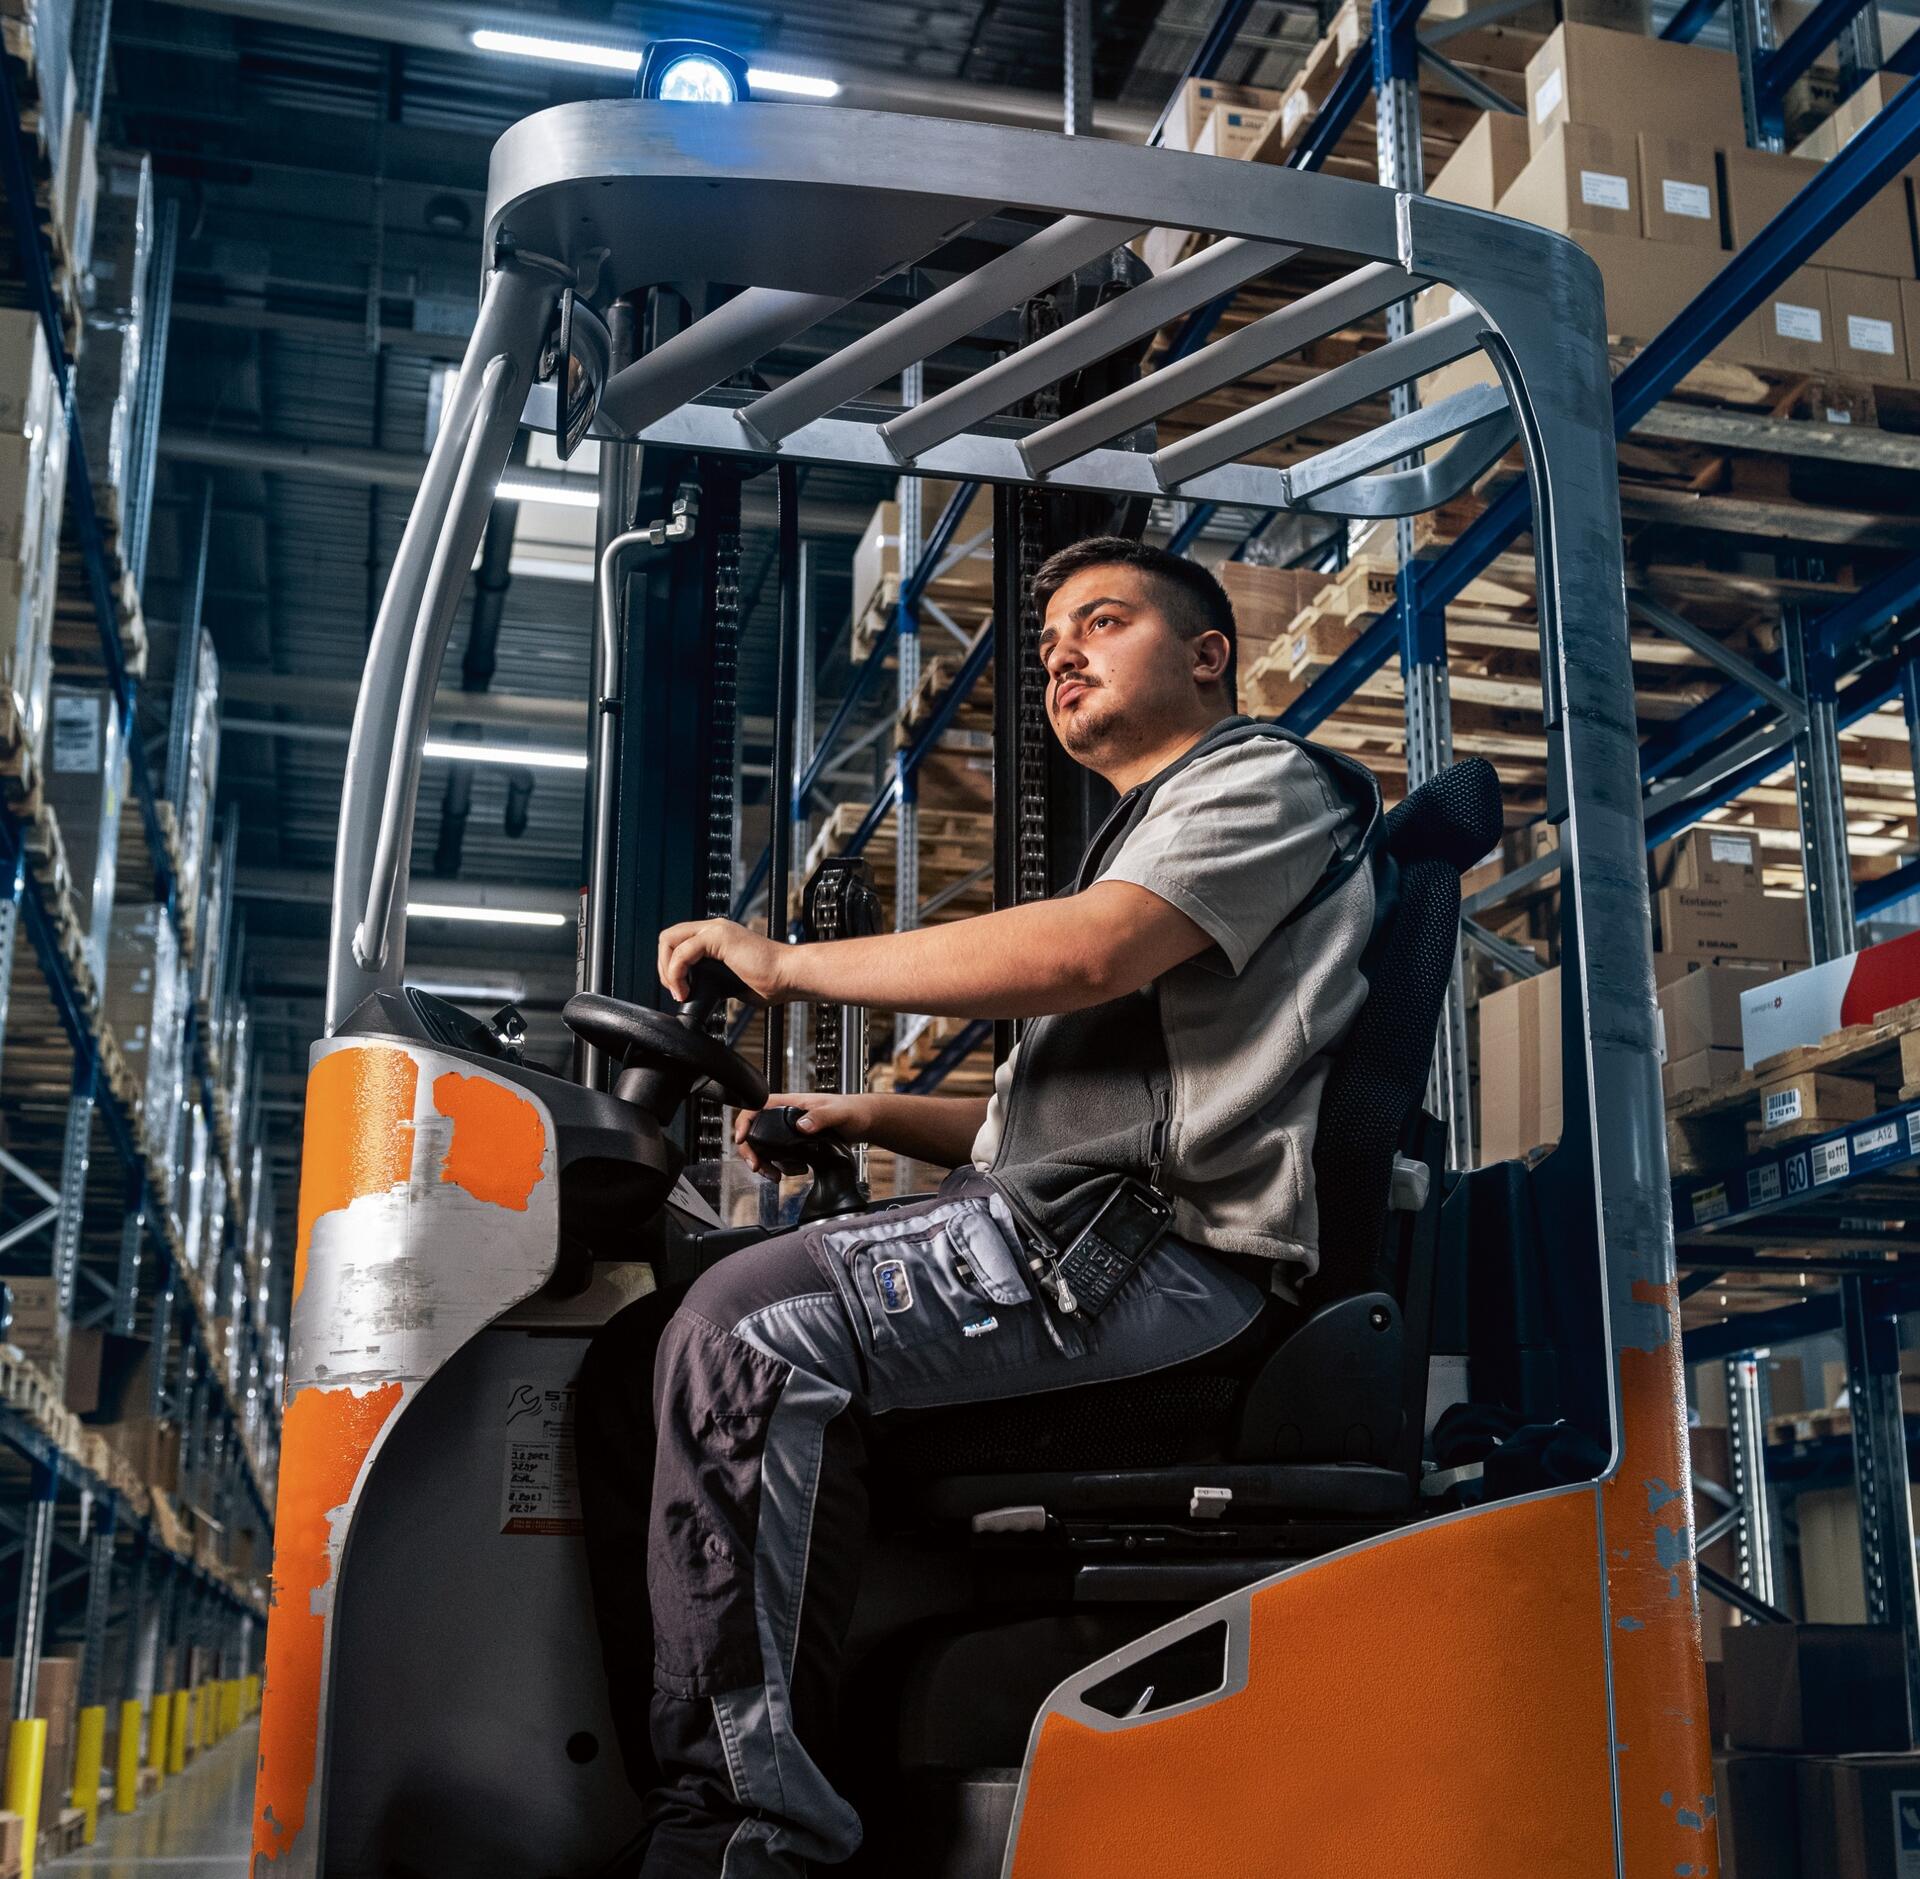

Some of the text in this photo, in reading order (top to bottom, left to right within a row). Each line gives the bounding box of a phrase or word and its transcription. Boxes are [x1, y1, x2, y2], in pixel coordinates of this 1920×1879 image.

[1877, 1126, 1893, 1142] A12
[1787, 1157, 1806, 1191] 60
[545, 1391, 576, 1401] ST
